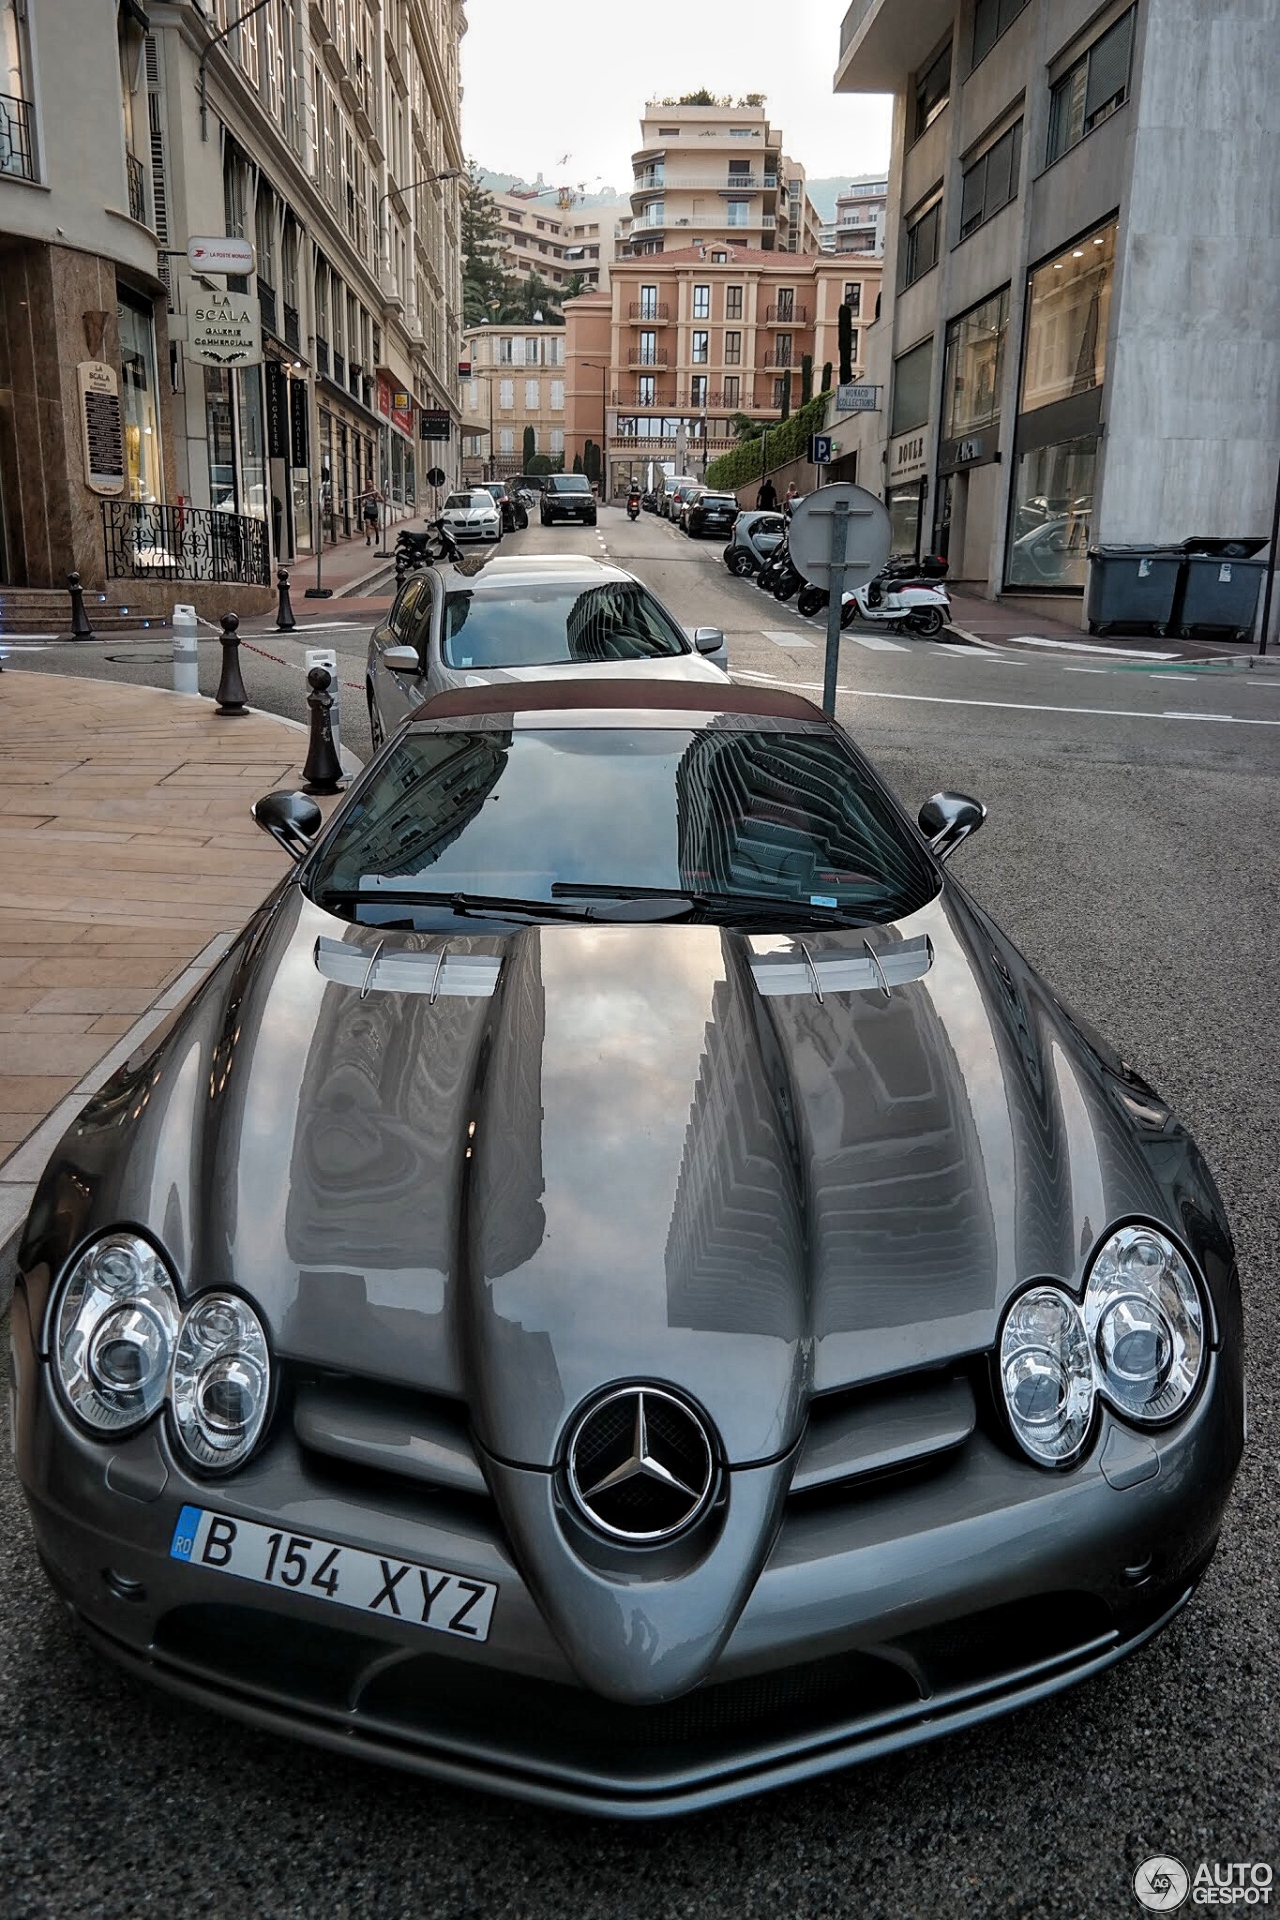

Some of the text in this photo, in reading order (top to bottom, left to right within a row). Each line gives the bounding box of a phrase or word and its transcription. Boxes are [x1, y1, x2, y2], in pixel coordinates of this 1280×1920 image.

[212, 294, 231, 306] LA
[195, 309, 251, 323] SCALA
[205, 327, 242, 337] GALERIE
[194, 337, 254, 347] COMMERCIALE
[89, 371, 110, 382] SCALA
[845, 389, 869, 397] MONACO
[838, 399, 874, 407] COLLECTIONS
[269, 365, 280, 454] OPERA GALLERY
[818, 440, 827, 458] P
[175, 1535, 192, 1554] RO
[202, 1516, 487, 1636] B 154 XYZ
